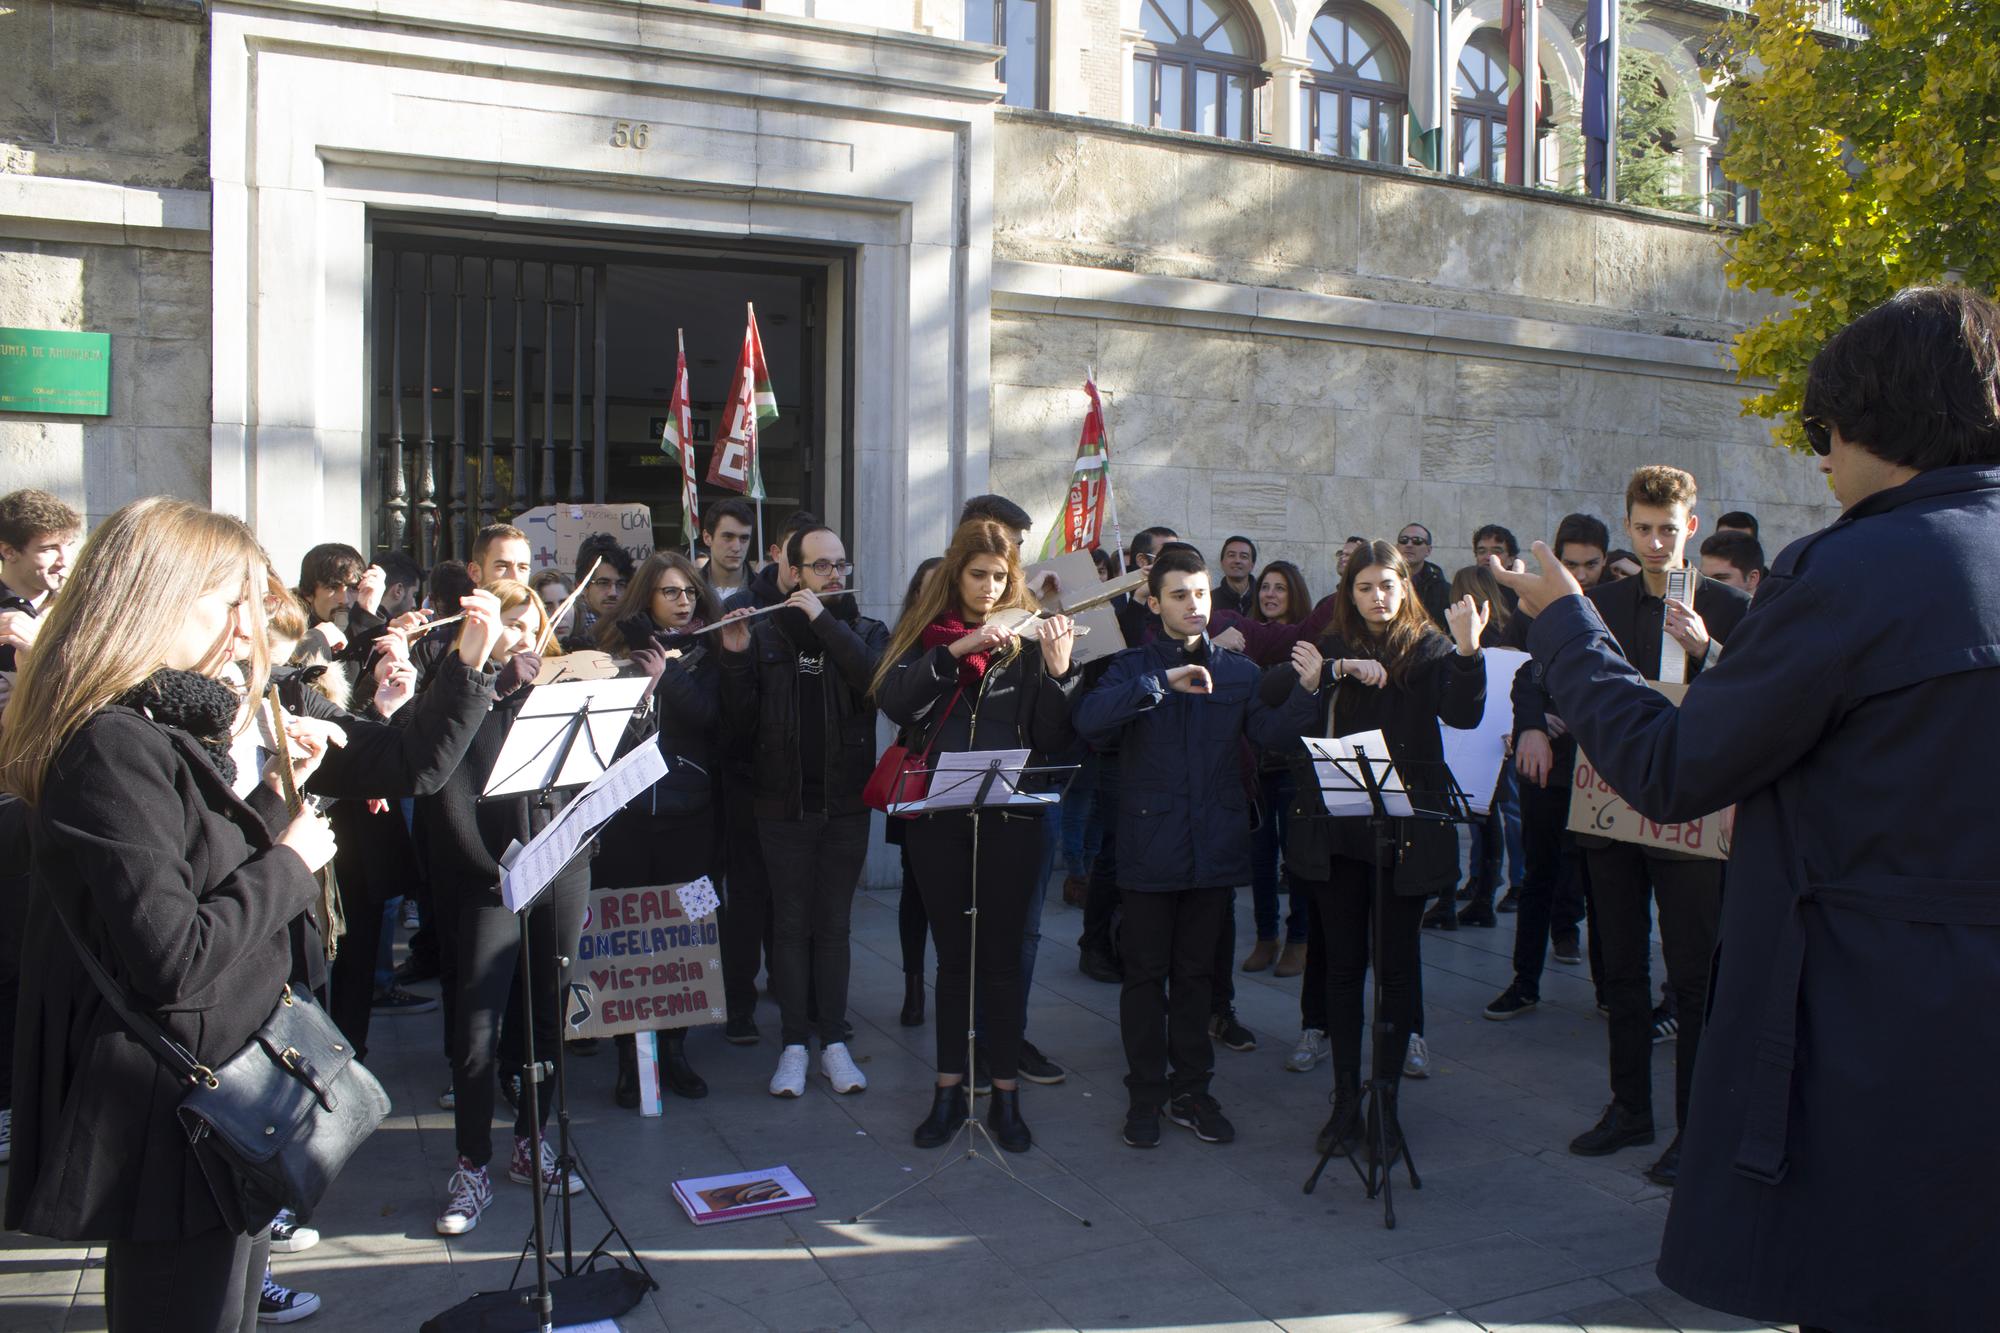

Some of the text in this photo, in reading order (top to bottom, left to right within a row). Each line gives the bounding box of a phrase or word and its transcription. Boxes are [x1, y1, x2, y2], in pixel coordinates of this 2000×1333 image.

[611, 121, 649, 149] 56
[32, 346, 45, 358] DE
[600, 889, 682, 930] REAL
[578, 920, 719, 961] ONGELATORIO
